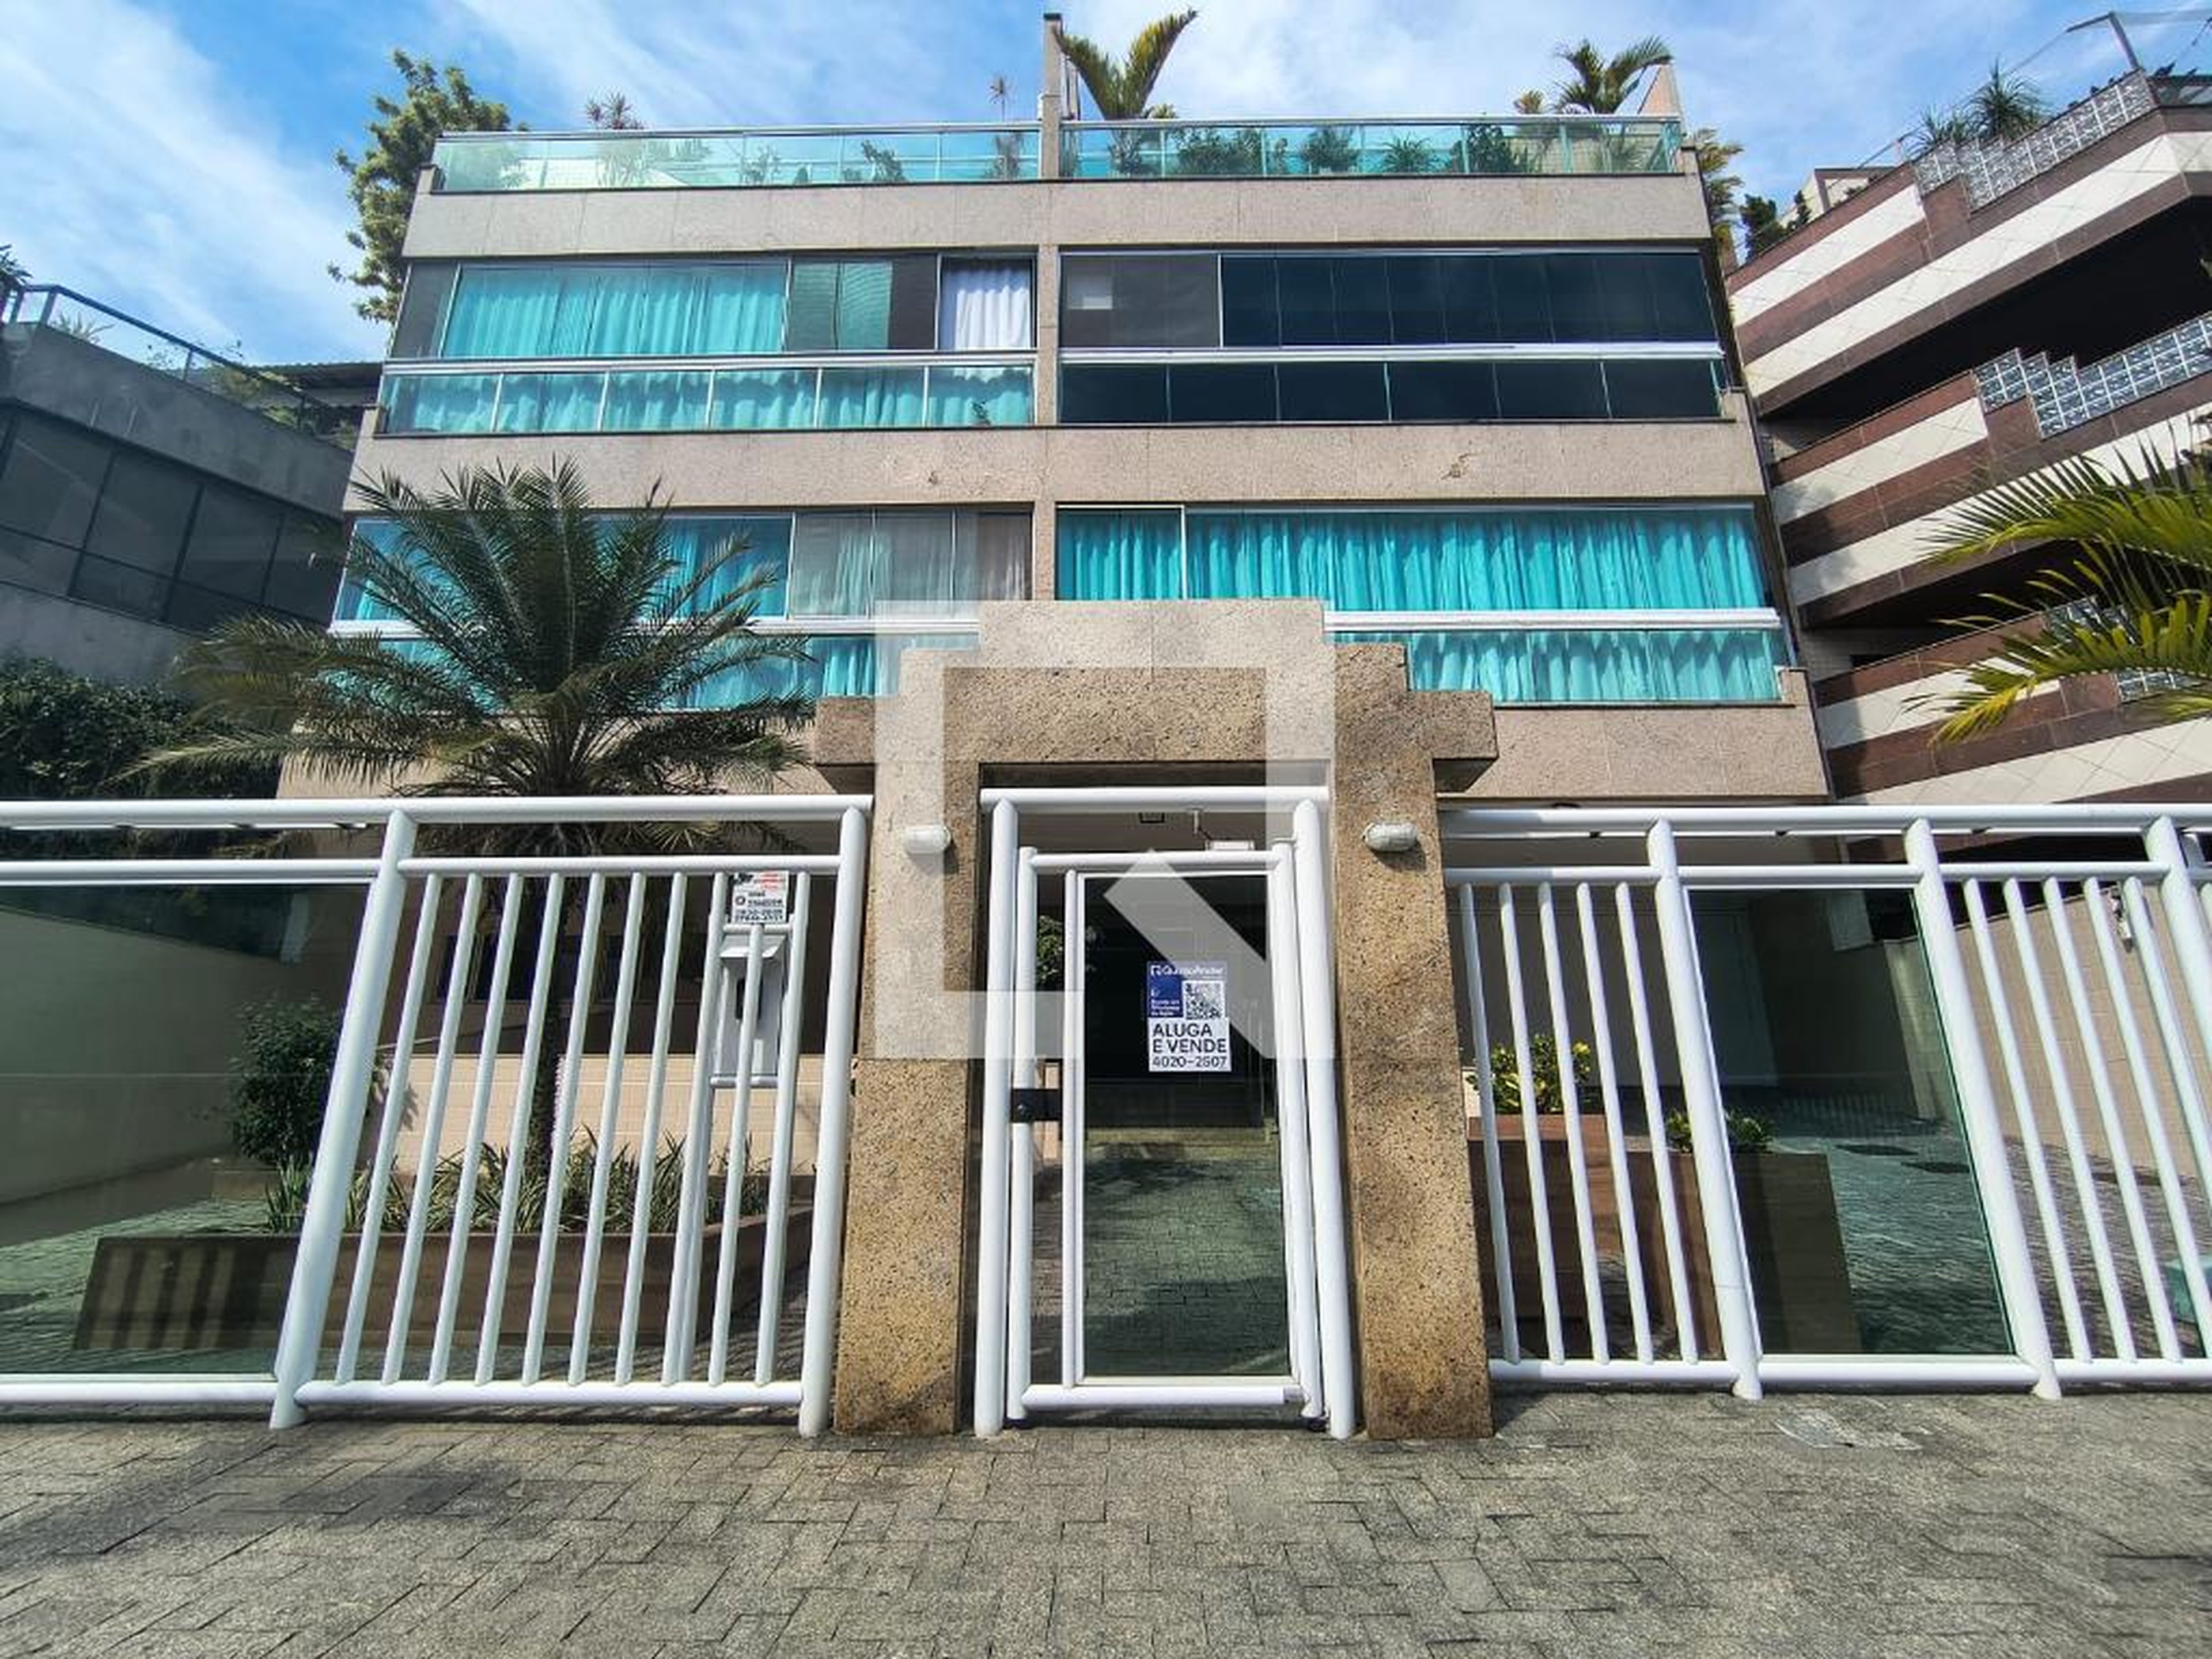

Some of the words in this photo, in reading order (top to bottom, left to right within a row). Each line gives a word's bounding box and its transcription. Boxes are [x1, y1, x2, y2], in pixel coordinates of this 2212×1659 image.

[1153, 1023, 1213, 1037] ALUGA
[1153, 1039, 1163, 1053] E
[1166, 1039, 1227, 1054] VENDE
[1153, 1055, 1227, 1069] 4020-2607
